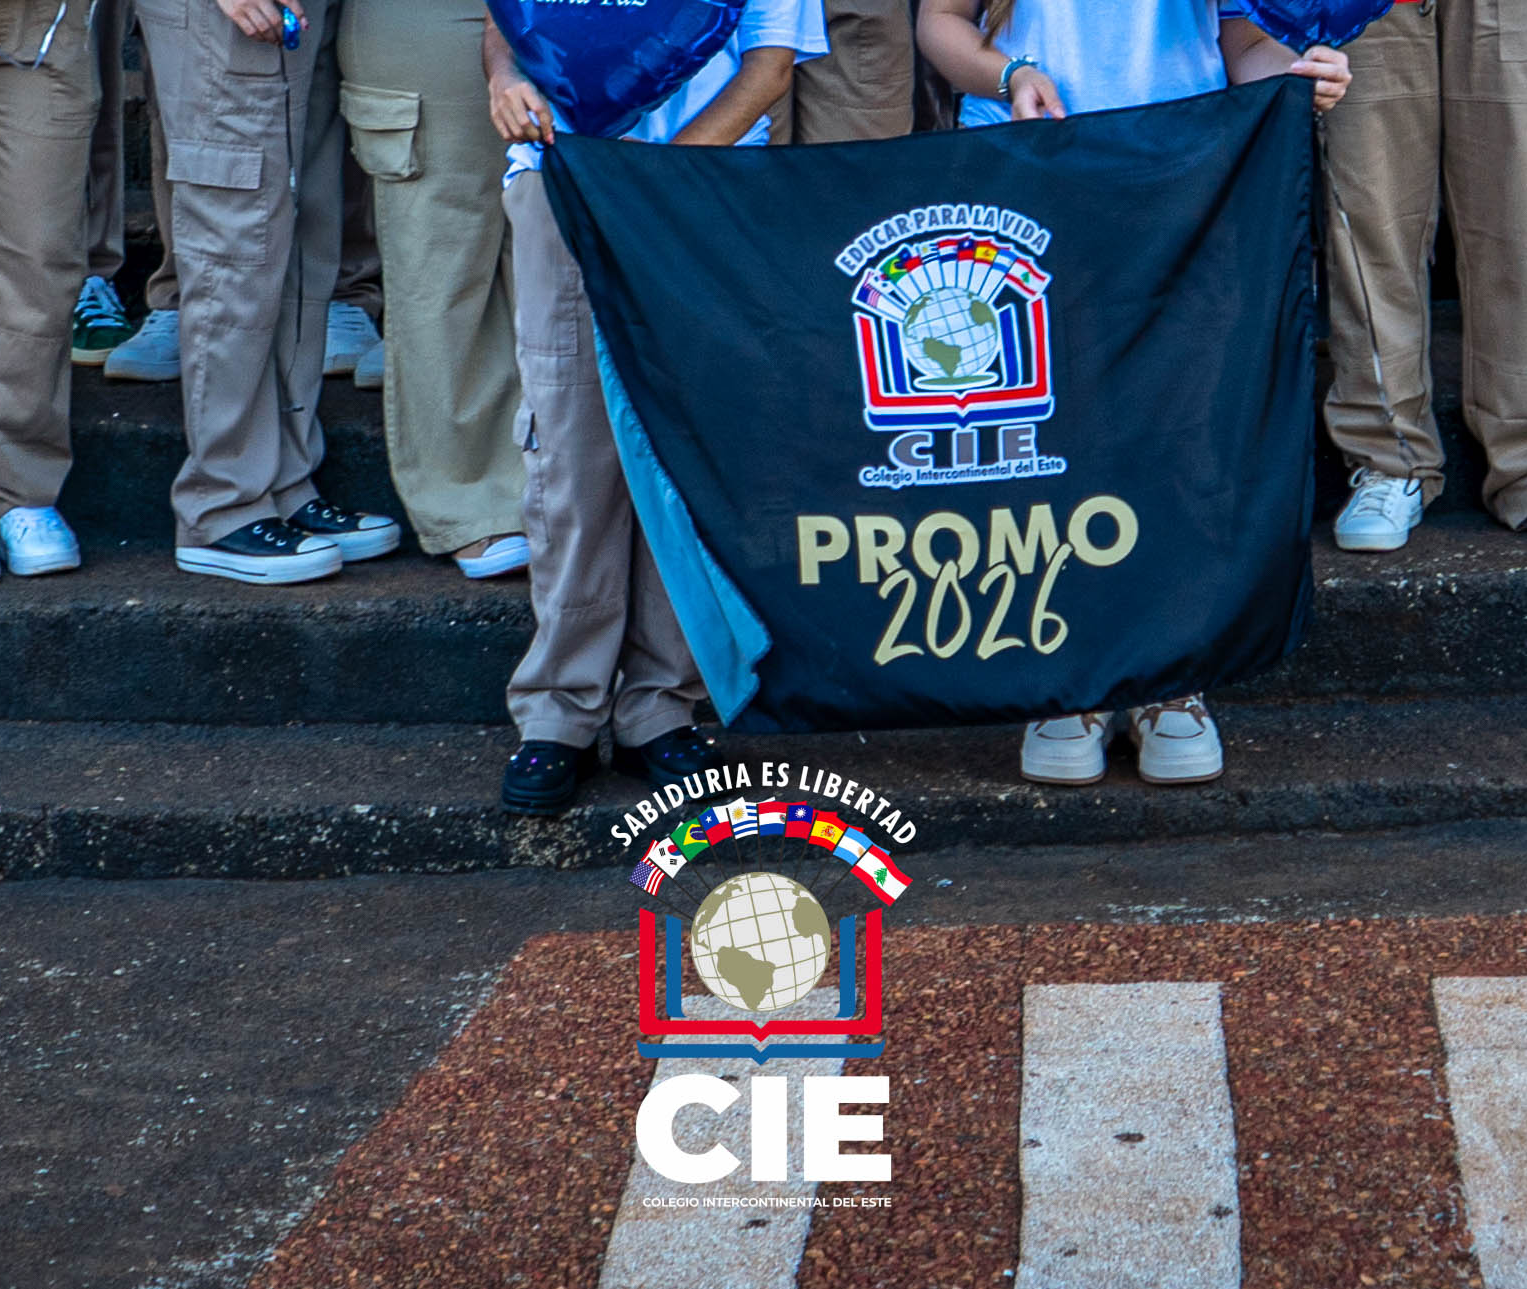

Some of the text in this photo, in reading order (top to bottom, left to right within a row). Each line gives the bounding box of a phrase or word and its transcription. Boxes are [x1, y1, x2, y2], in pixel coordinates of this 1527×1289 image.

[838, 206, 1049, 273] EDUCAR PARA LA VIDA
[862, 458, 1064, 486] Colegio Intercontinental del Este
[890, 425, 1036, 467] CIE
[797, 495, 1139, 585] PROMO
[873, 543, 1073, 666] 2026
